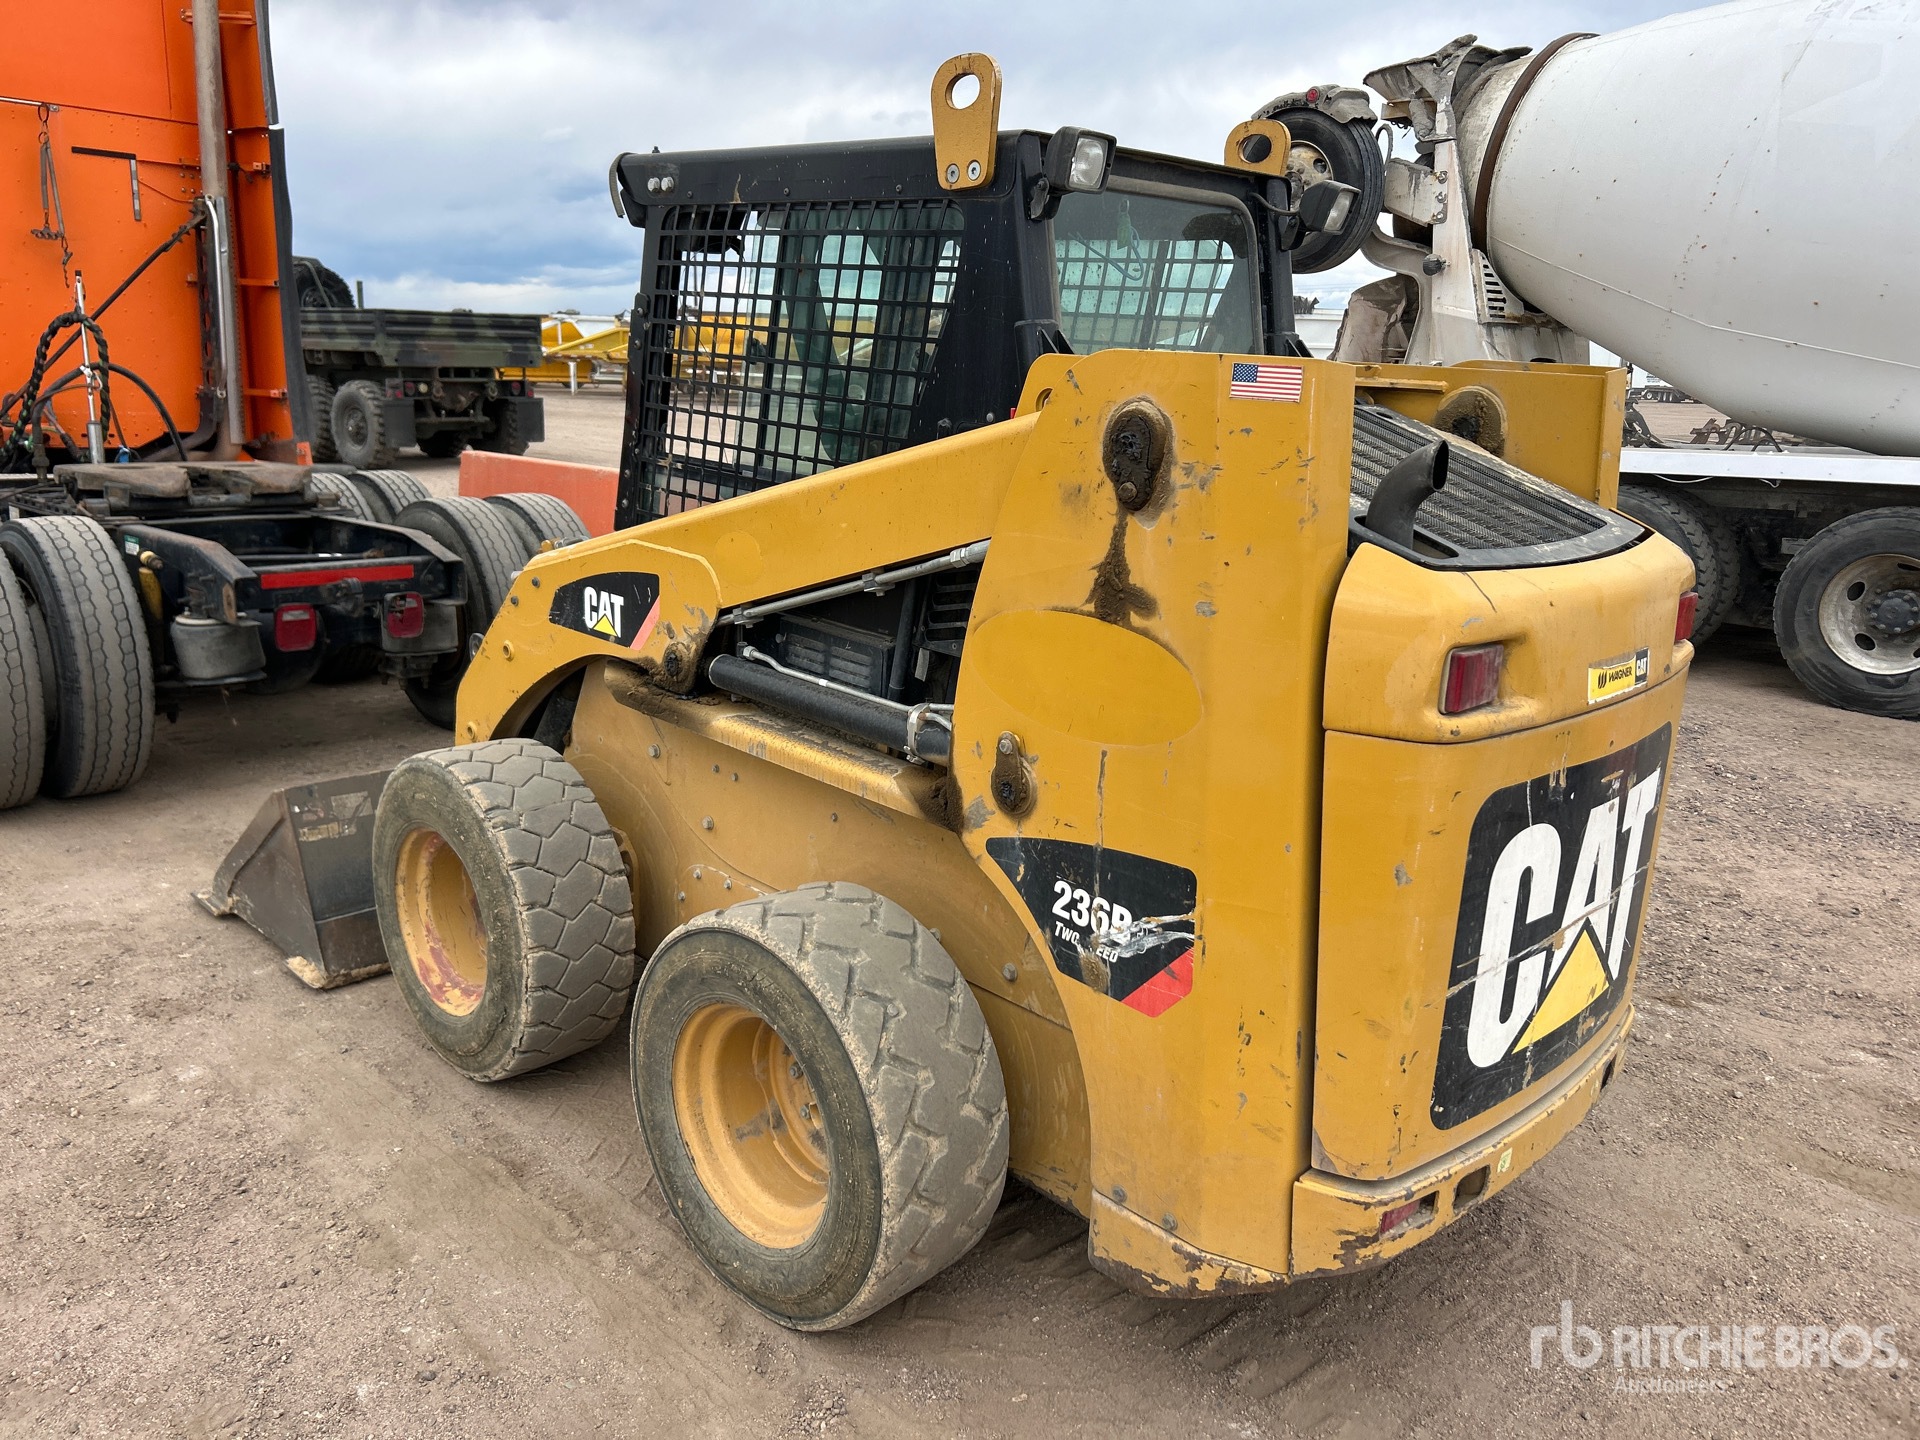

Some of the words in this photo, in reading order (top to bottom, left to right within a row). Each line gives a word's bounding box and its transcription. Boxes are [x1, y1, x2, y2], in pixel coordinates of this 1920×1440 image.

[584, 586, 624, 638] CAT
[1608, 666, 1633, 683] WAGNER
[1636, 657, 1647, 677] CAT
[1467, 768, 1661, 1068] CAT
